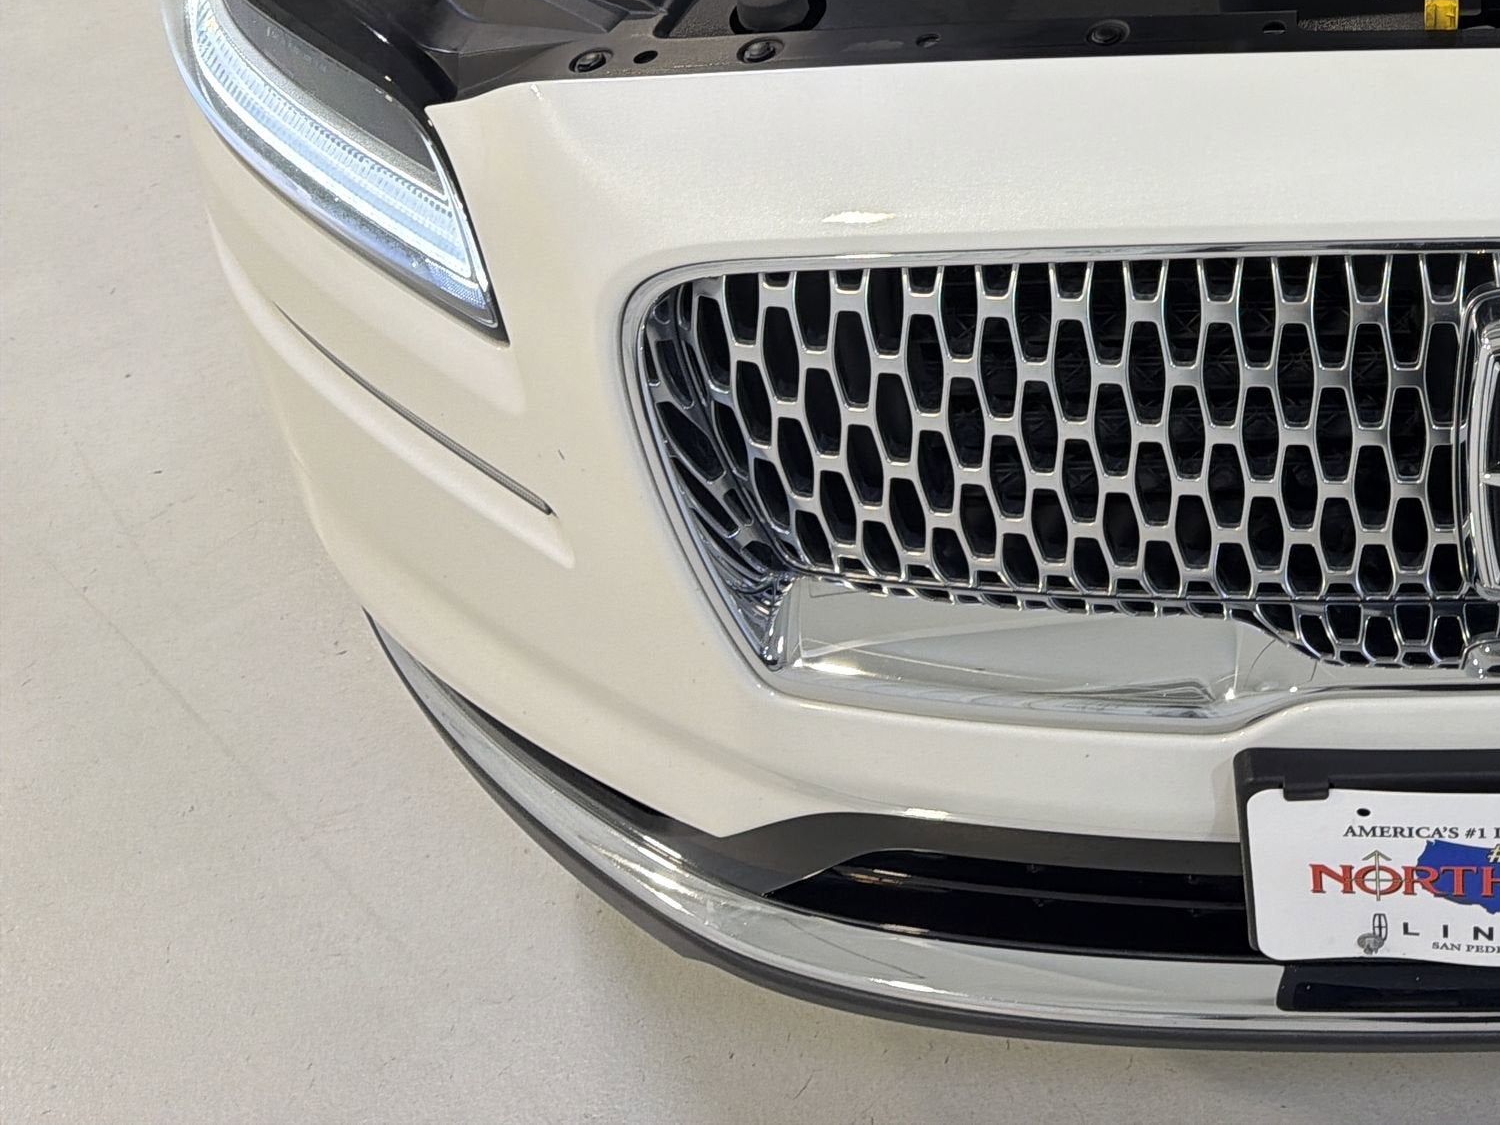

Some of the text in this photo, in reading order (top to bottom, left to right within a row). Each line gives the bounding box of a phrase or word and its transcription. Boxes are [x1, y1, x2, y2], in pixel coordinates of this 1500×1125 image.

[1343, 825, 1459, 839] AMERICA'S
[1465, 827, 1487, 839] #1
[1432, 941, 1462, 952] SAN
